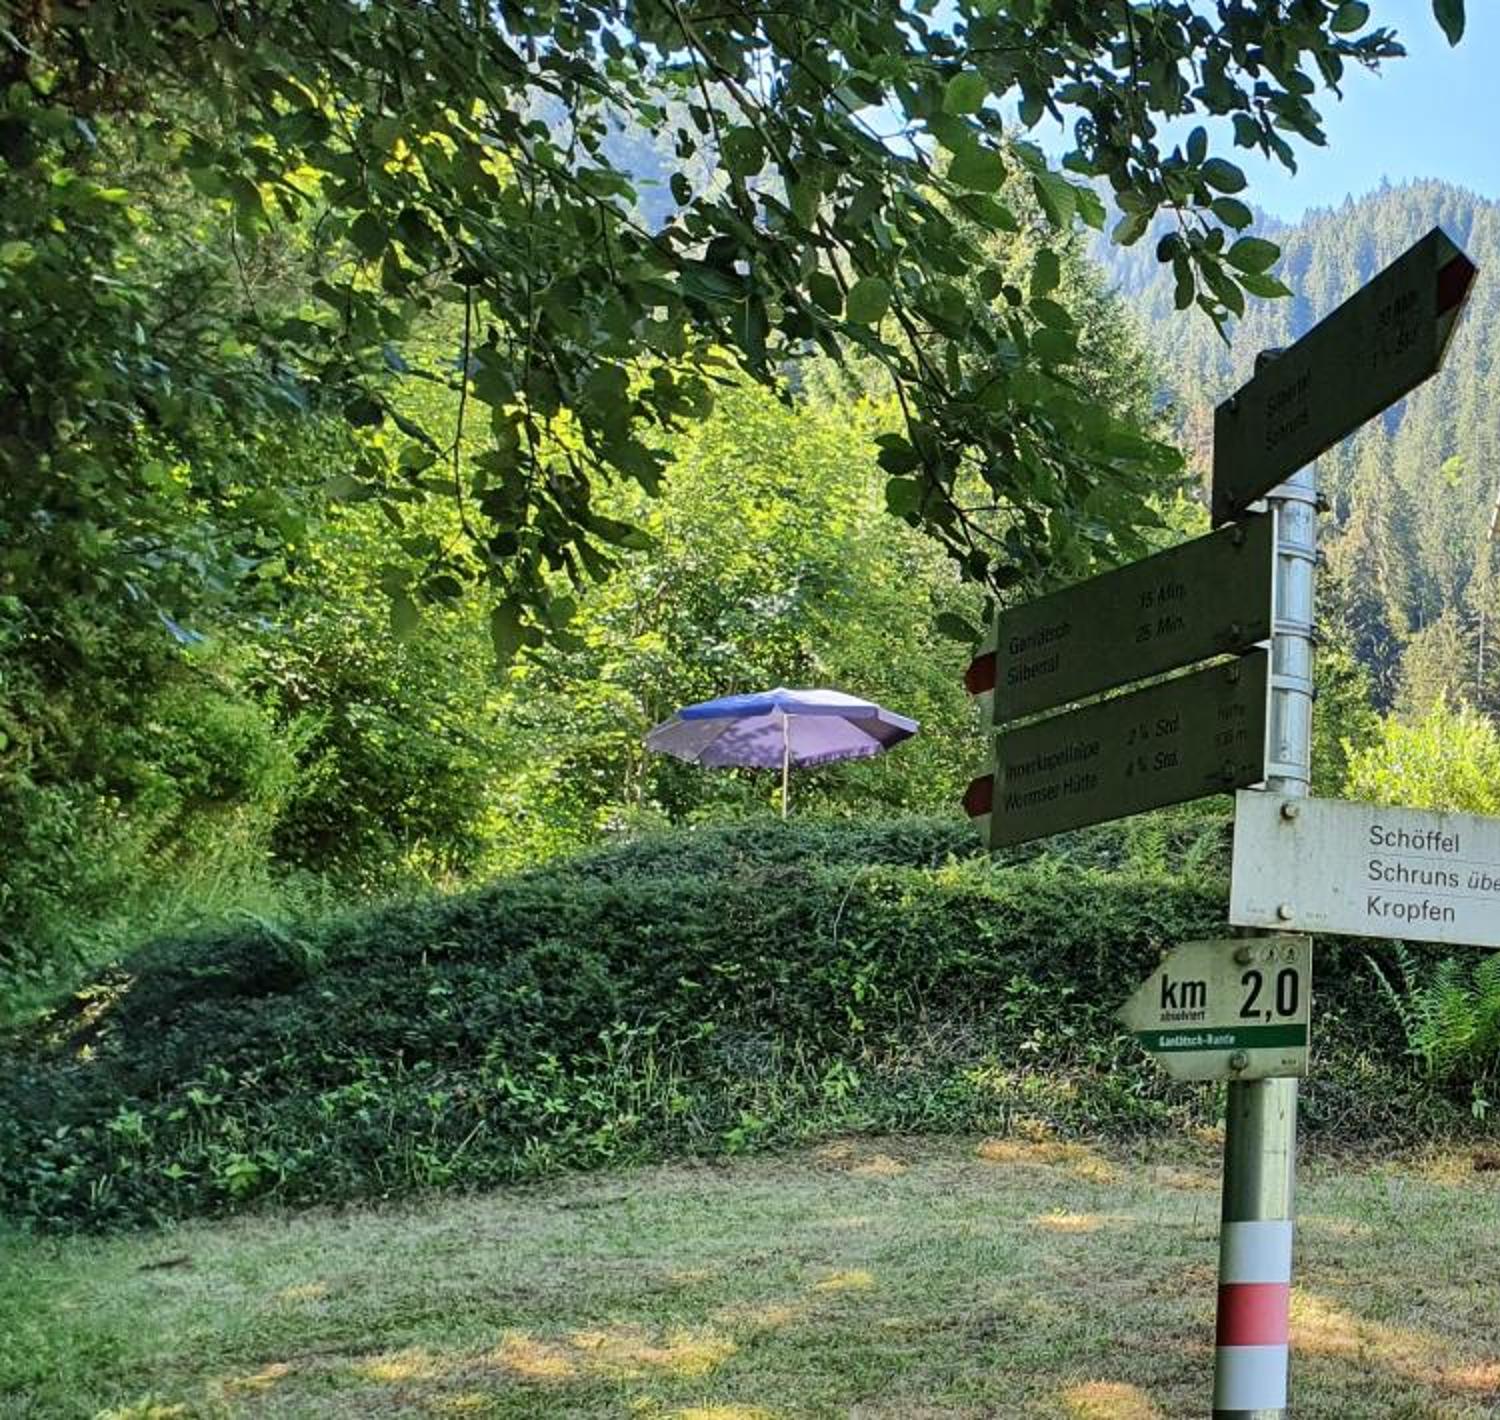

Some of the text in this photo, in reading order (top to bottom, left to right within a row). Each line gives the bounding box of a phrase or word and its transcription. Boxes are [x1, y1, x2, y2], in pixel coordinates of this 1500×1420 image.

[1369, 825, 1460, 853] Schöffel
[1368, 860, 1459, 888] Schruns
[1367, 896, 1456, 923] Kropfen
[1160, 968, 1298, 1022] km 2,0
